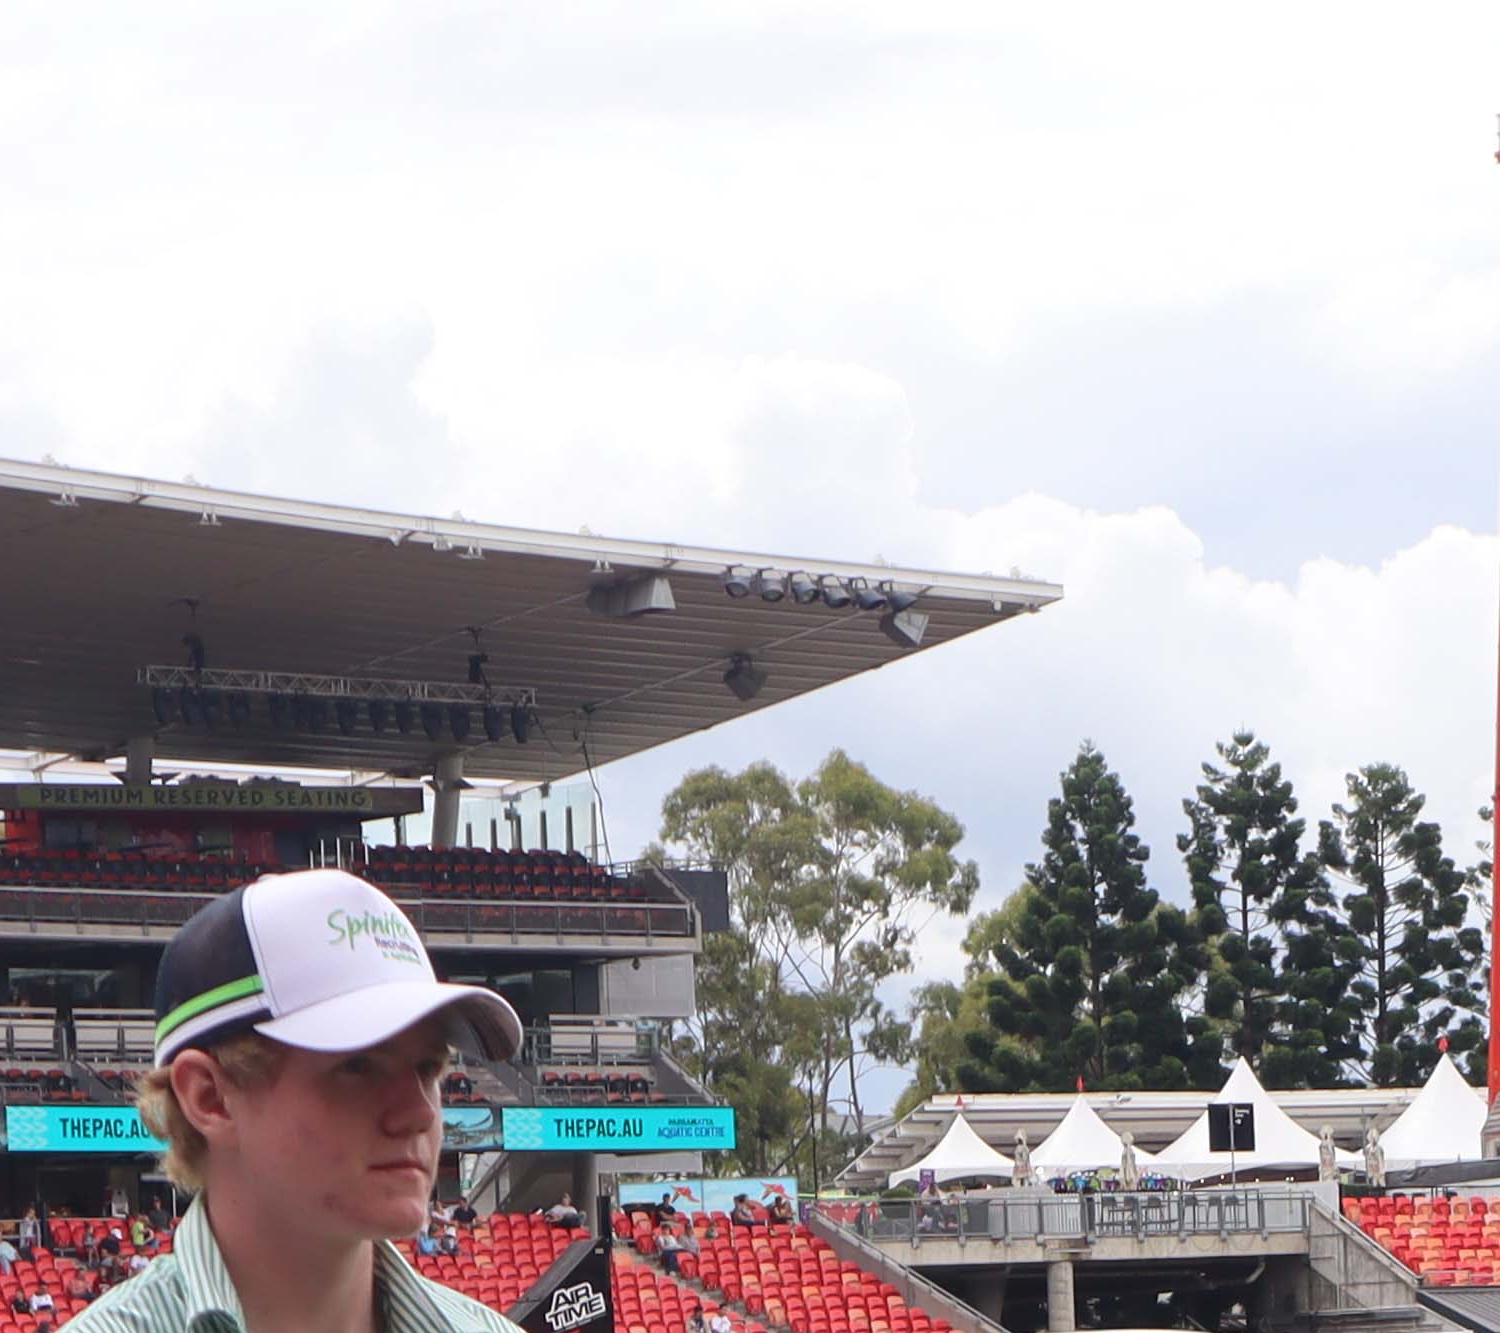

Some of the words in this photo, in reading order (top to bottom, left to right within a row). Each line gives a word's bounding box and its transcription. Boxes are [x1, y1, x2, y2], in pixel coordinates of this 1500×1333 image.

[40, 788, 143, 802] PREMIUM
[153, 789, 263, 804] RESERVED
[274, 791, 366, 806] SEATING
[554, 1118, 643, 1138] THEPAC.AU
[657, 1126, 693, 1139] AQUATIC
[695, 1126, 725, 1138] CENTRE
